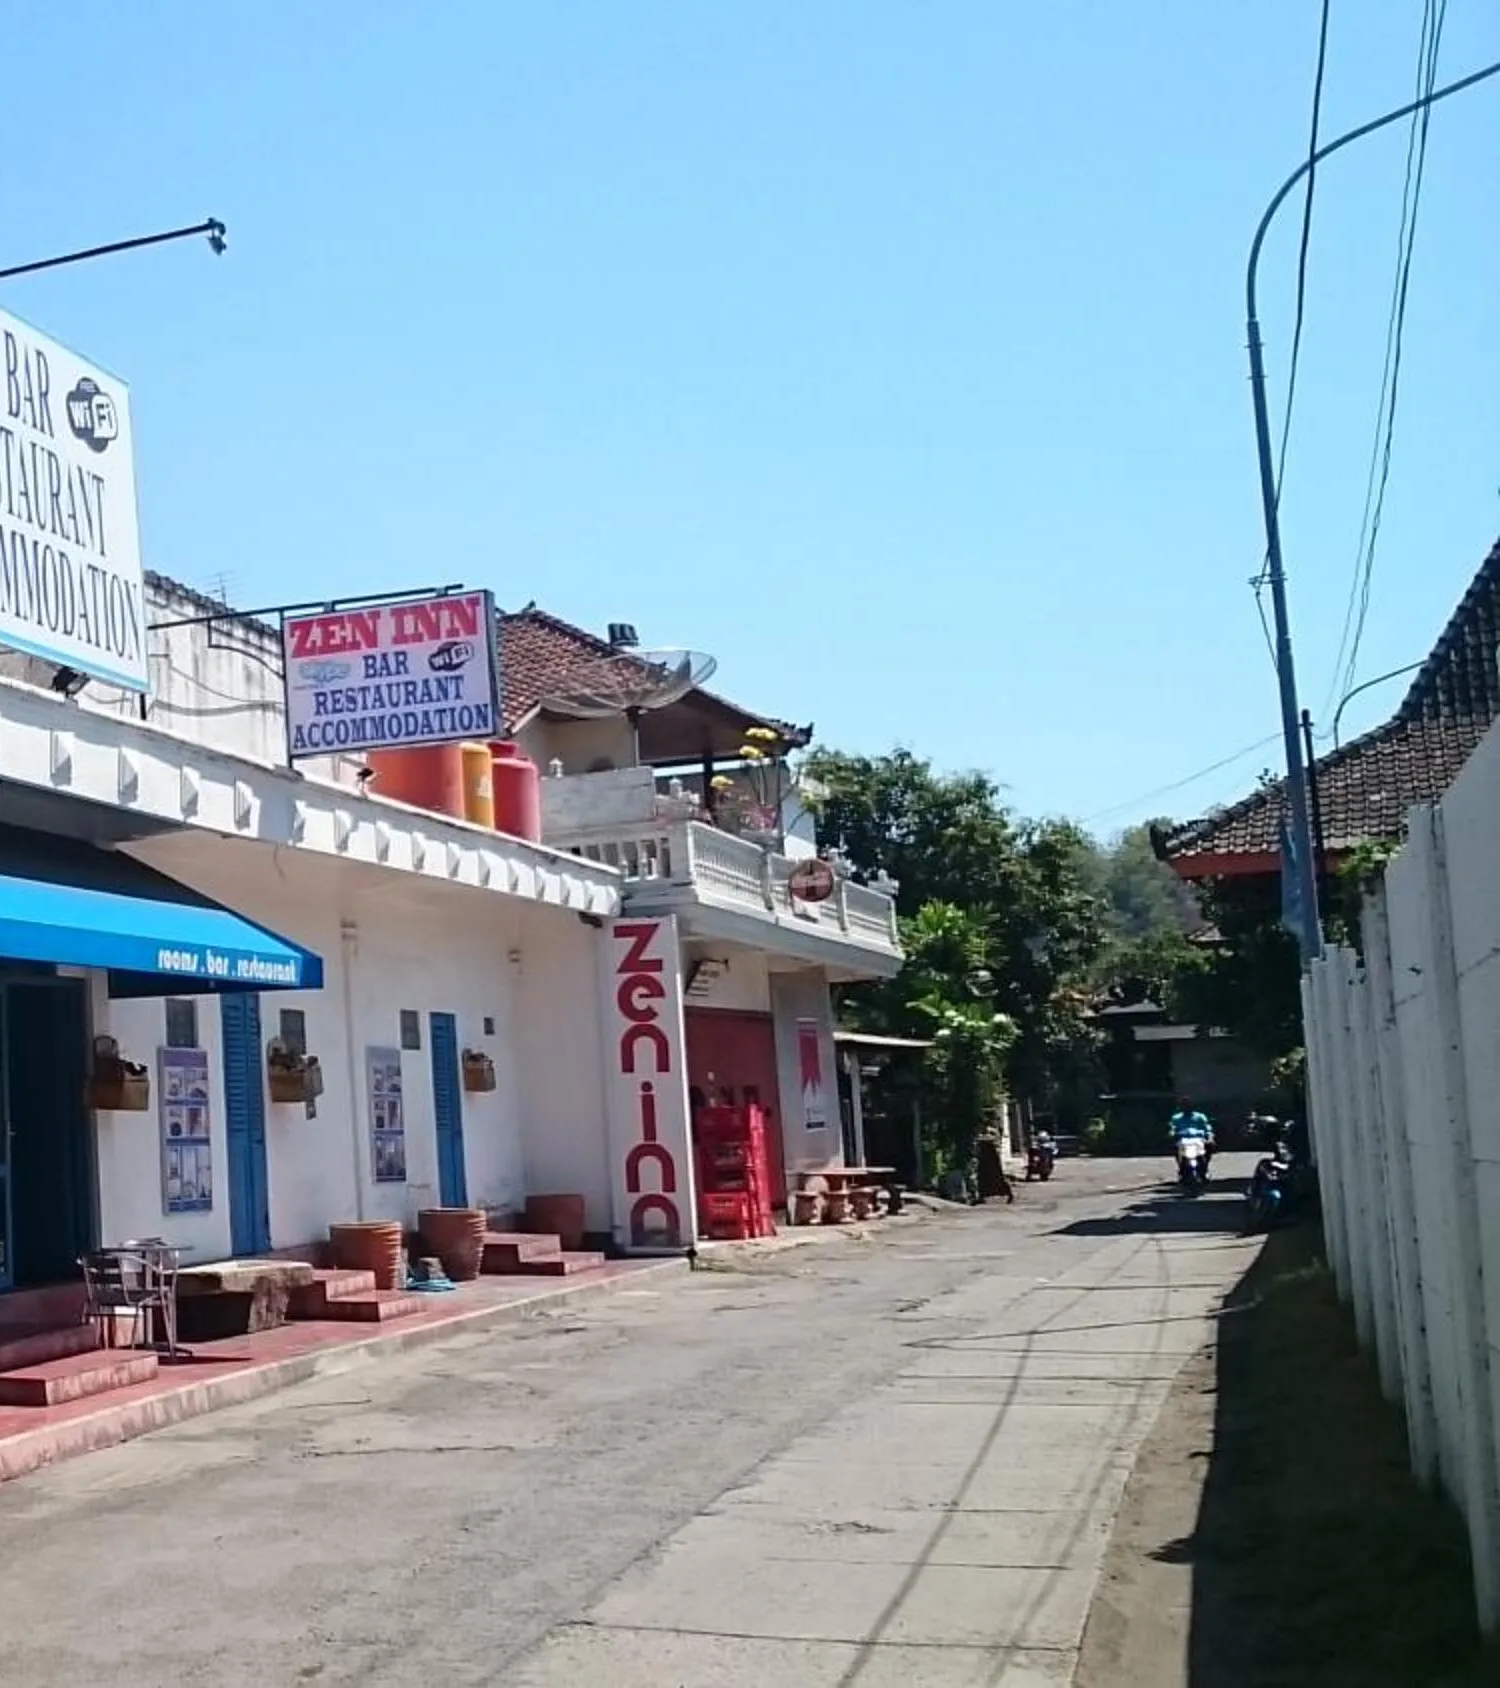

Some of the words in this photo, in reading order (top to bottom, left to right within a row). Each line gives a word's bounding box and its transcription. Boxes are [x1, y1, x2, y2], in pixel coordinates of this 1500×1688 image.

[4, 330, 54, 438] BAR
[289, 611, 380, 658] ZEN
[389, 597, 480, 644] INN
[363, 651, 409, 679] BAR
[314, 675, 464, 716] RESTAURANT
[293, 703, 489, 748] ACCOMMODATION
[158, 949, 198, 973] rooms
[206, 949, 229, 975] bar
[237, 954, 296, 982] restaurant
[625, 1081, 681, 1247] inn
